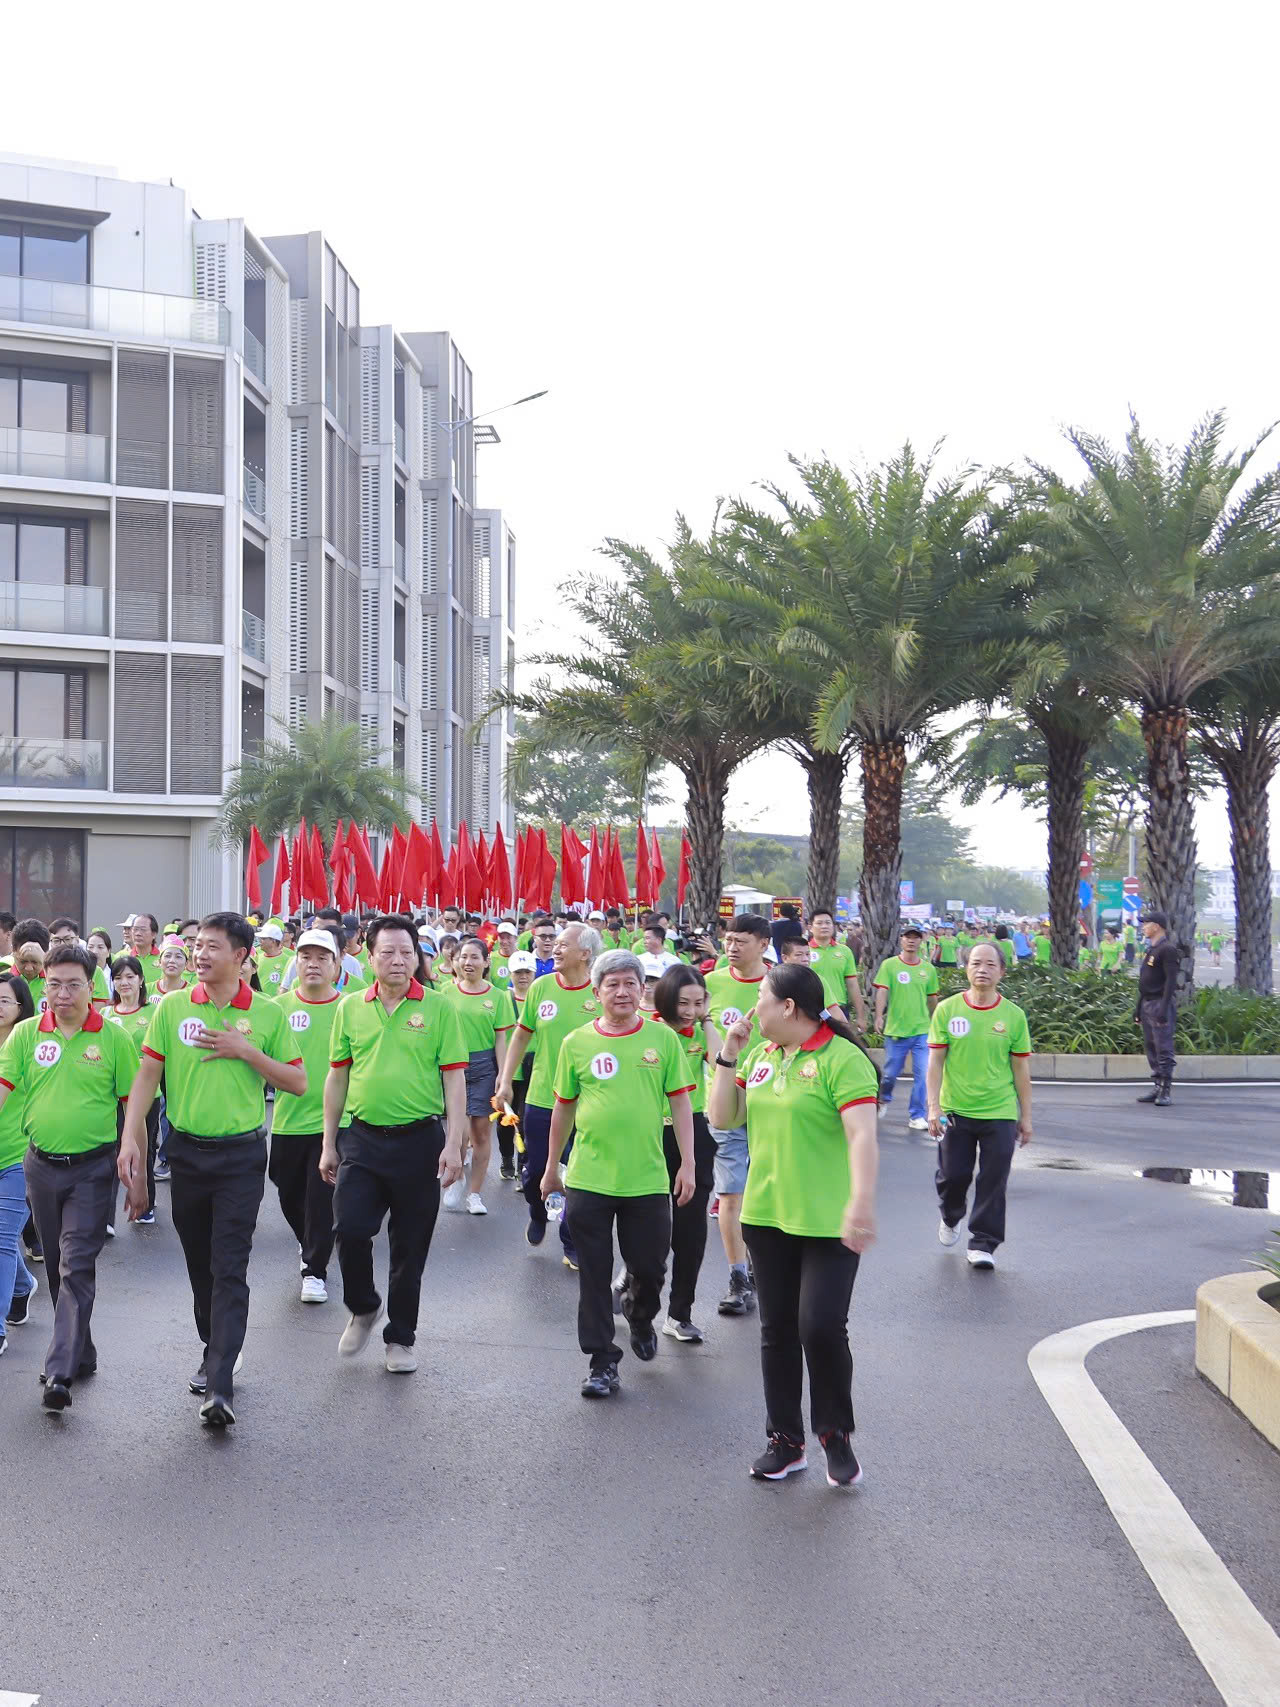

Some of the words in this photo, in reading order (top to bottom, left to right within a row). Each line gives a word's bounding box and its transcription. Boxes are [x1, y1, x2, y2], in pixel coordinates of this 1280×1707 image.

[541, 1003, 554, 1017] 22
[291, 1014, 307, 1028] 112
[951, 1021, 966, 1033] 111
[38, 1045, 57, 1061] 33
[595, 1057, 613, 1074] 16
